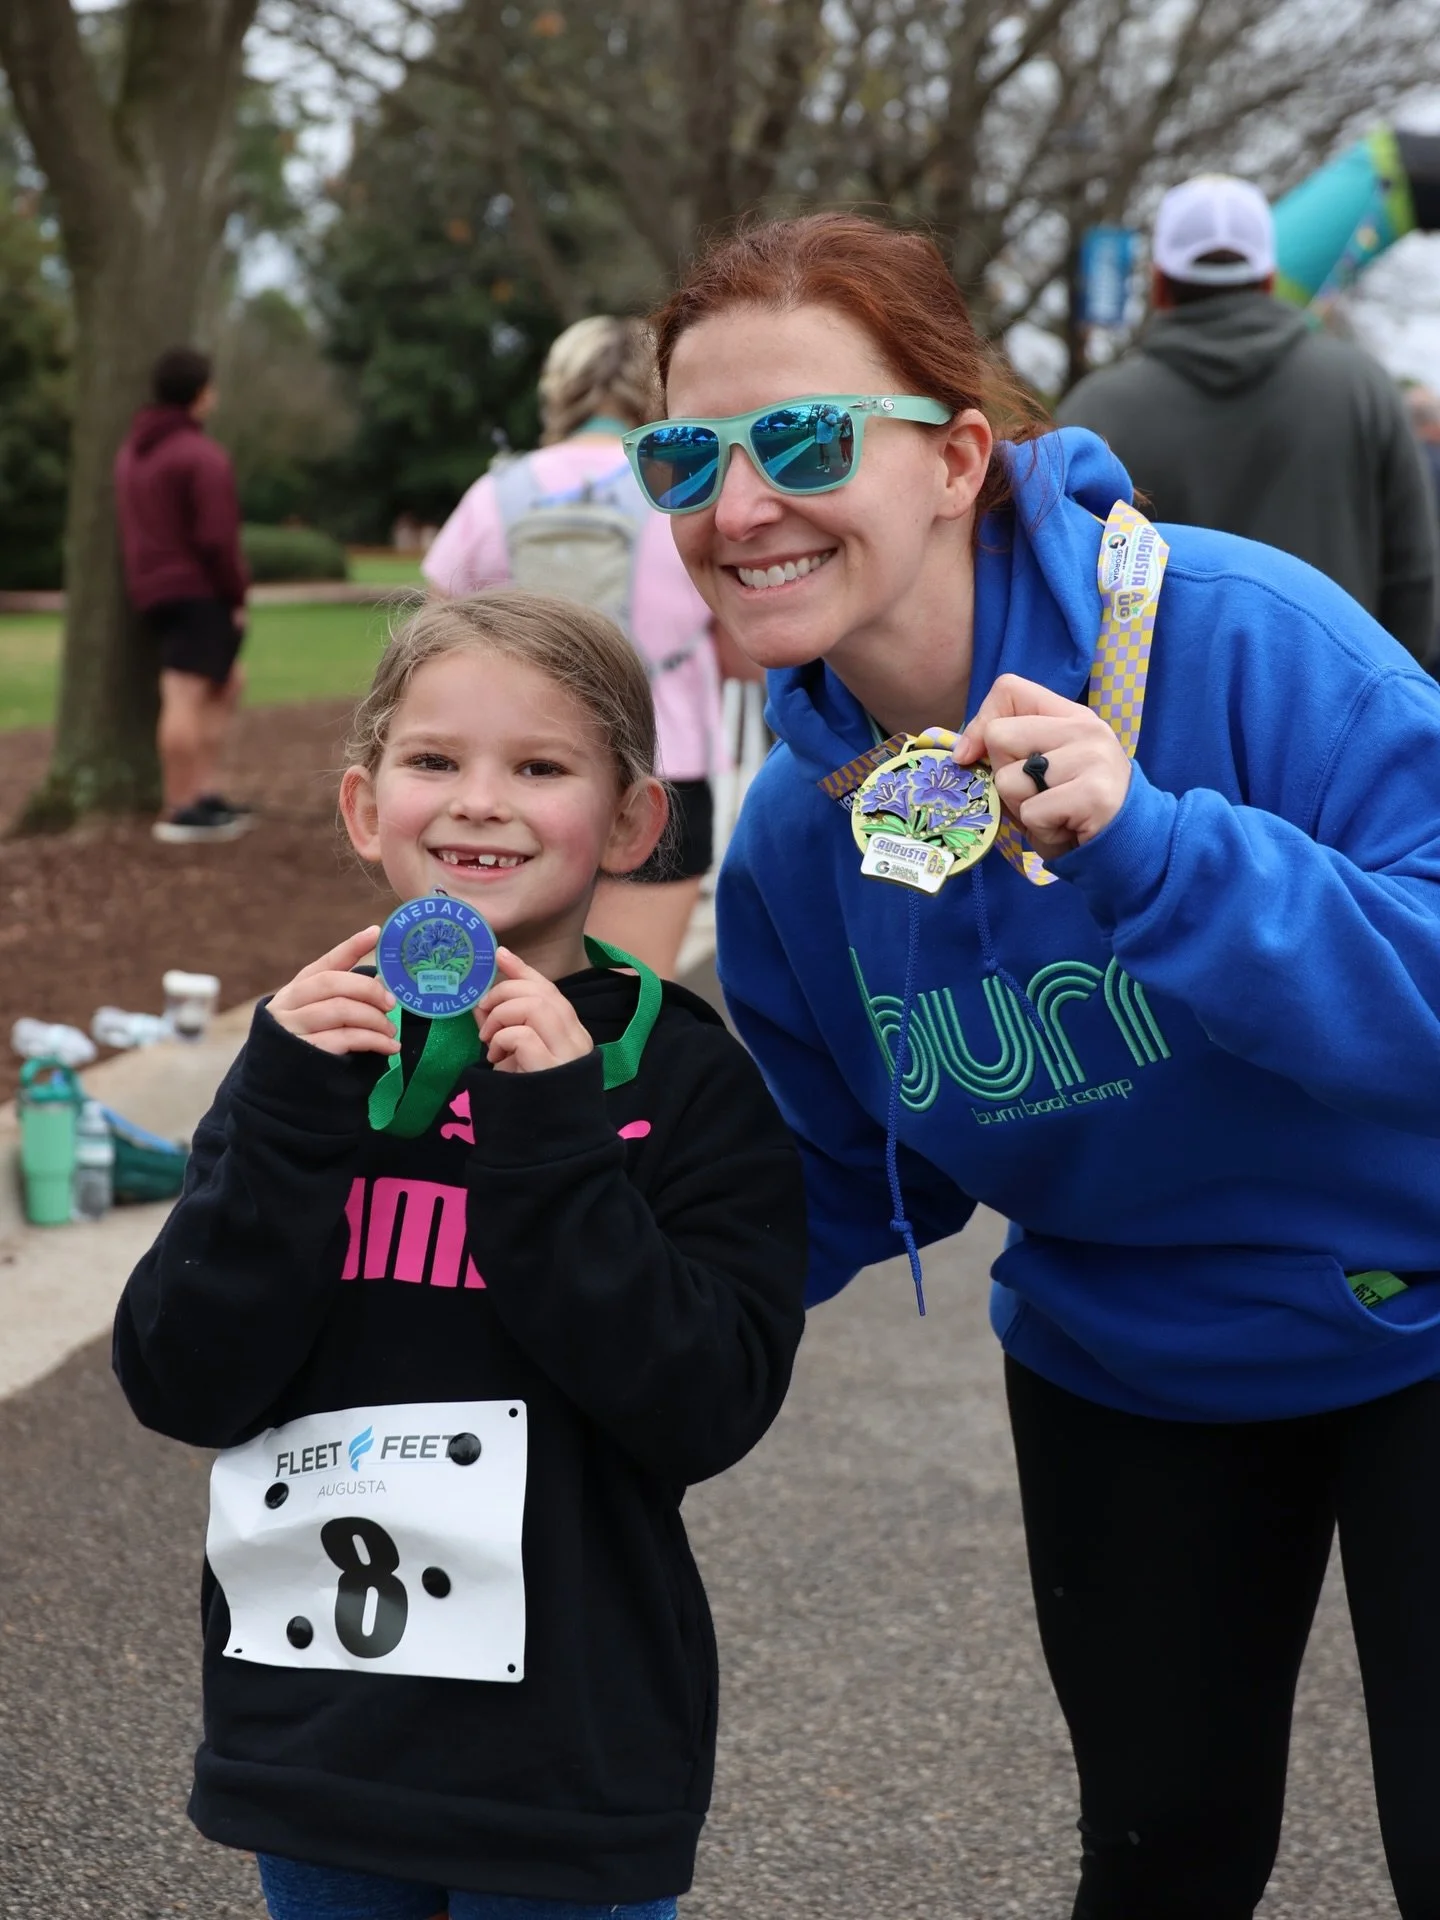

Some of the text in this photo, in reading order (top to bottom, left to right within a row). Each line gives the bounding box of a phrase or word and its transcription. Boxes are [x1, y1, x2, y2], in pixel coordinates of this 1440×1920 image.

[1113, 549, 1124, 581] GEORGIA
[1131, 527, 1157, 586] AUGUSTA
[877, 840, 928, 862] AUGUSTA
[394, 901, 481, 930] MEDALS
[393, 983, 479, 1012] FOR MILES
[1020, 1090, 1072, 1116] boot
[1072, 1078, 1134, 1104] camp
[275, 1434, 454, 1478] FLEET FEET
[317, 1480, 387, 1498] AUGUSTA
[320, 1516, 409, 1659] 8
